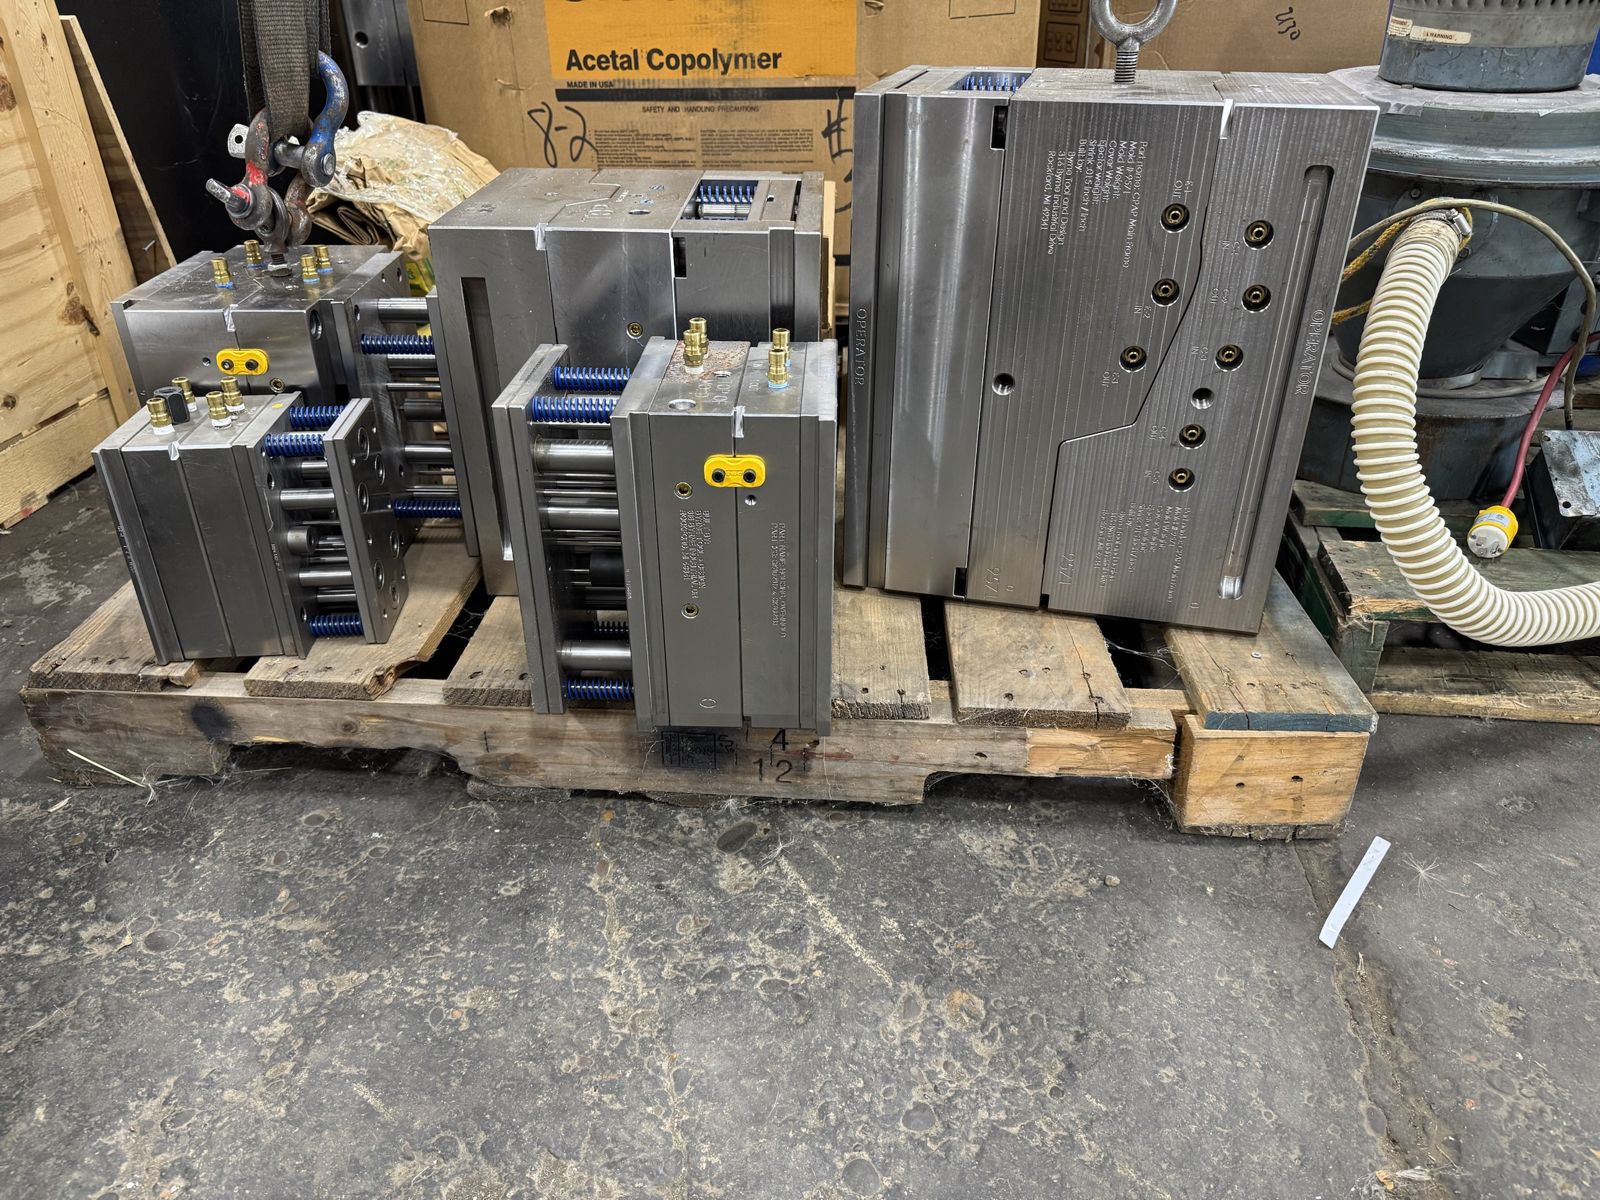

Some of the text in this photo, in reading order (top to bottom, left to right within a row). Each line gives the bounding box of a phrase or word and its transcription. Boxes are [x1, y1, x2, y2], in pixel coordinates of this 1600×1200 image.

[566, 48, 783, 76] Acetal Copolymer
[566, 81, 588, 89] MADE
[527, 101, 599, 169] 8-2
[1086, 139, 1098, 165] Shrink
[1106, 140, 1118, 169] Cover
[1116, 140, 1128, 164] Mold
[1127, 140, 1138, 164] Mold
[1043, 150, 1057, 192] Rockford,
[1063, 178, 1073, 196] Tool
[1061, 197, 1070, 215] and
[1130, 192, 1141, 218] CPAP
[1057, 216, 1069, 246] Design
[1126, 218, 1137, 240] Main
[855, 308, 867, 385] OPERATOR
[1294, 309, 1326, 395] OPERATOR
